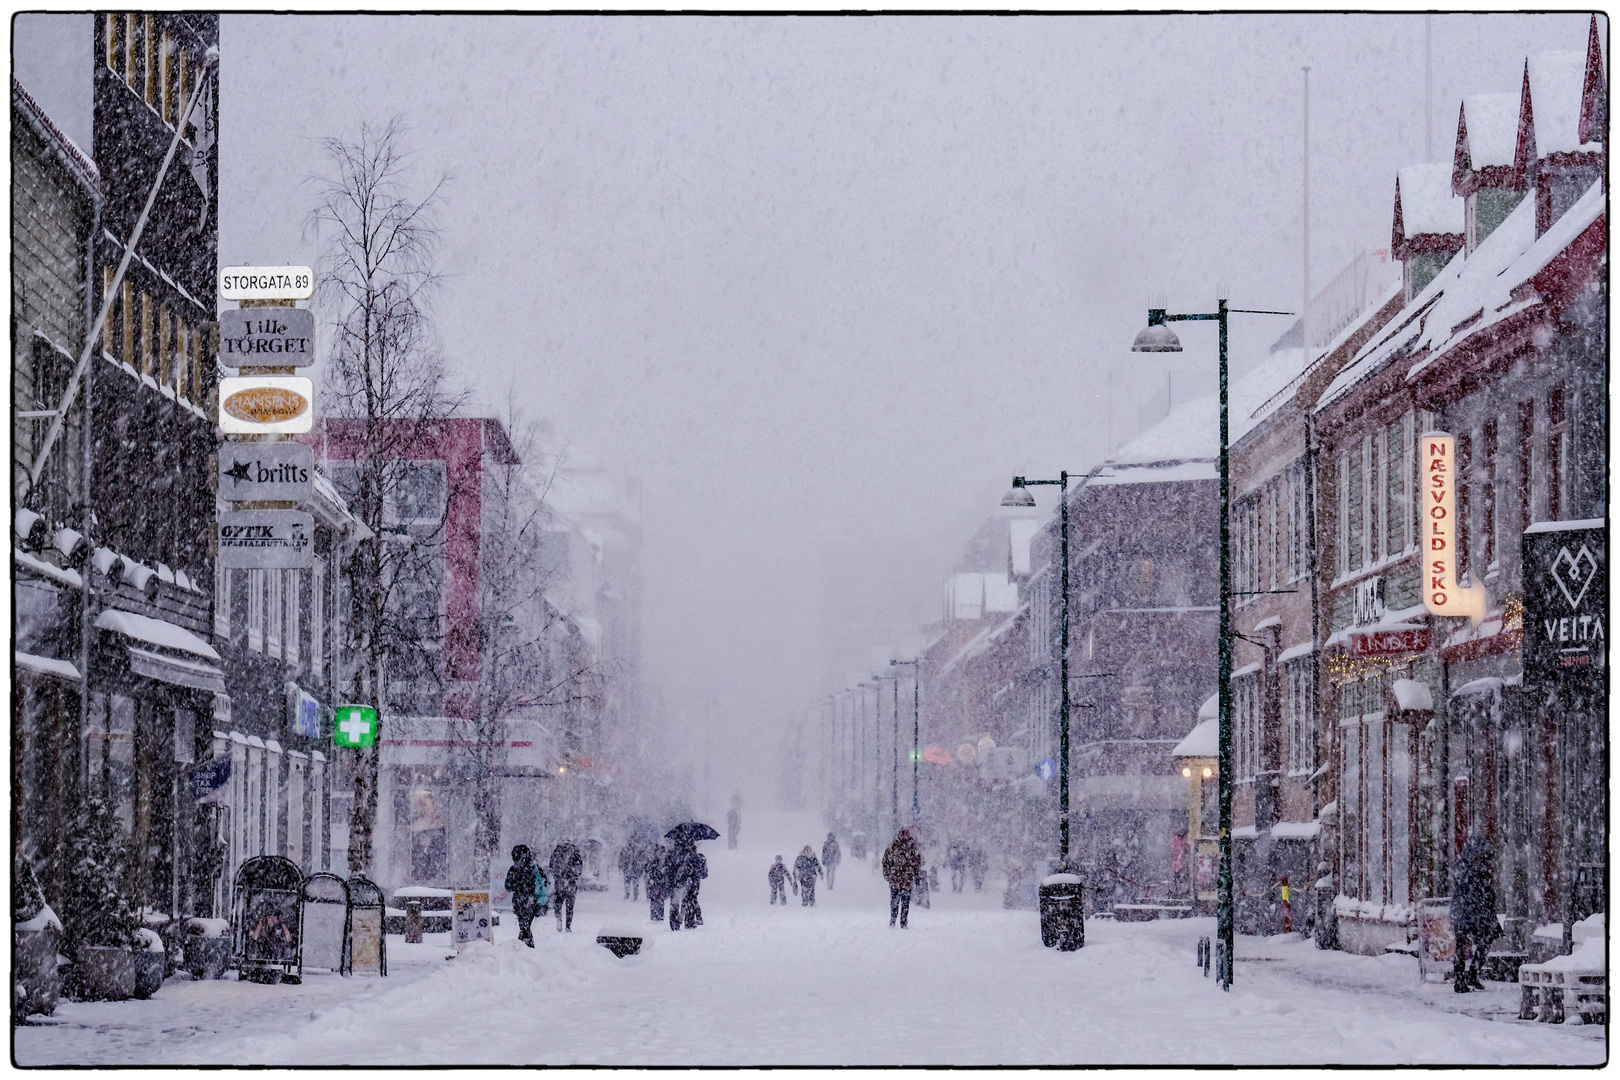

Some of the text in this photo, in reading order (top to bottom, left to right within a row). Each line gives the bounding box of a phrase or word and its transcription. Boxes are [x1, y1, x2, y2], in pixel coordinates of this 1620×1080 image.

[224, 274, 309, 290] STORGATA 89
[244, 319, 289, 336] Lille
[231, 395, 300, 410] HANSENS
[256, 460, 308, 483] britts
[221, 525, 274, 538] OPTIK
[1429, 443, 1448, 606] NÆSVOLD SKO
[1544, 615, 1605, 641] VEITA
[1356, 630, 1426, 652] LINDEX
[196, 771, 217, 779] SHOP
[196, 779, 211, 787] TAX
